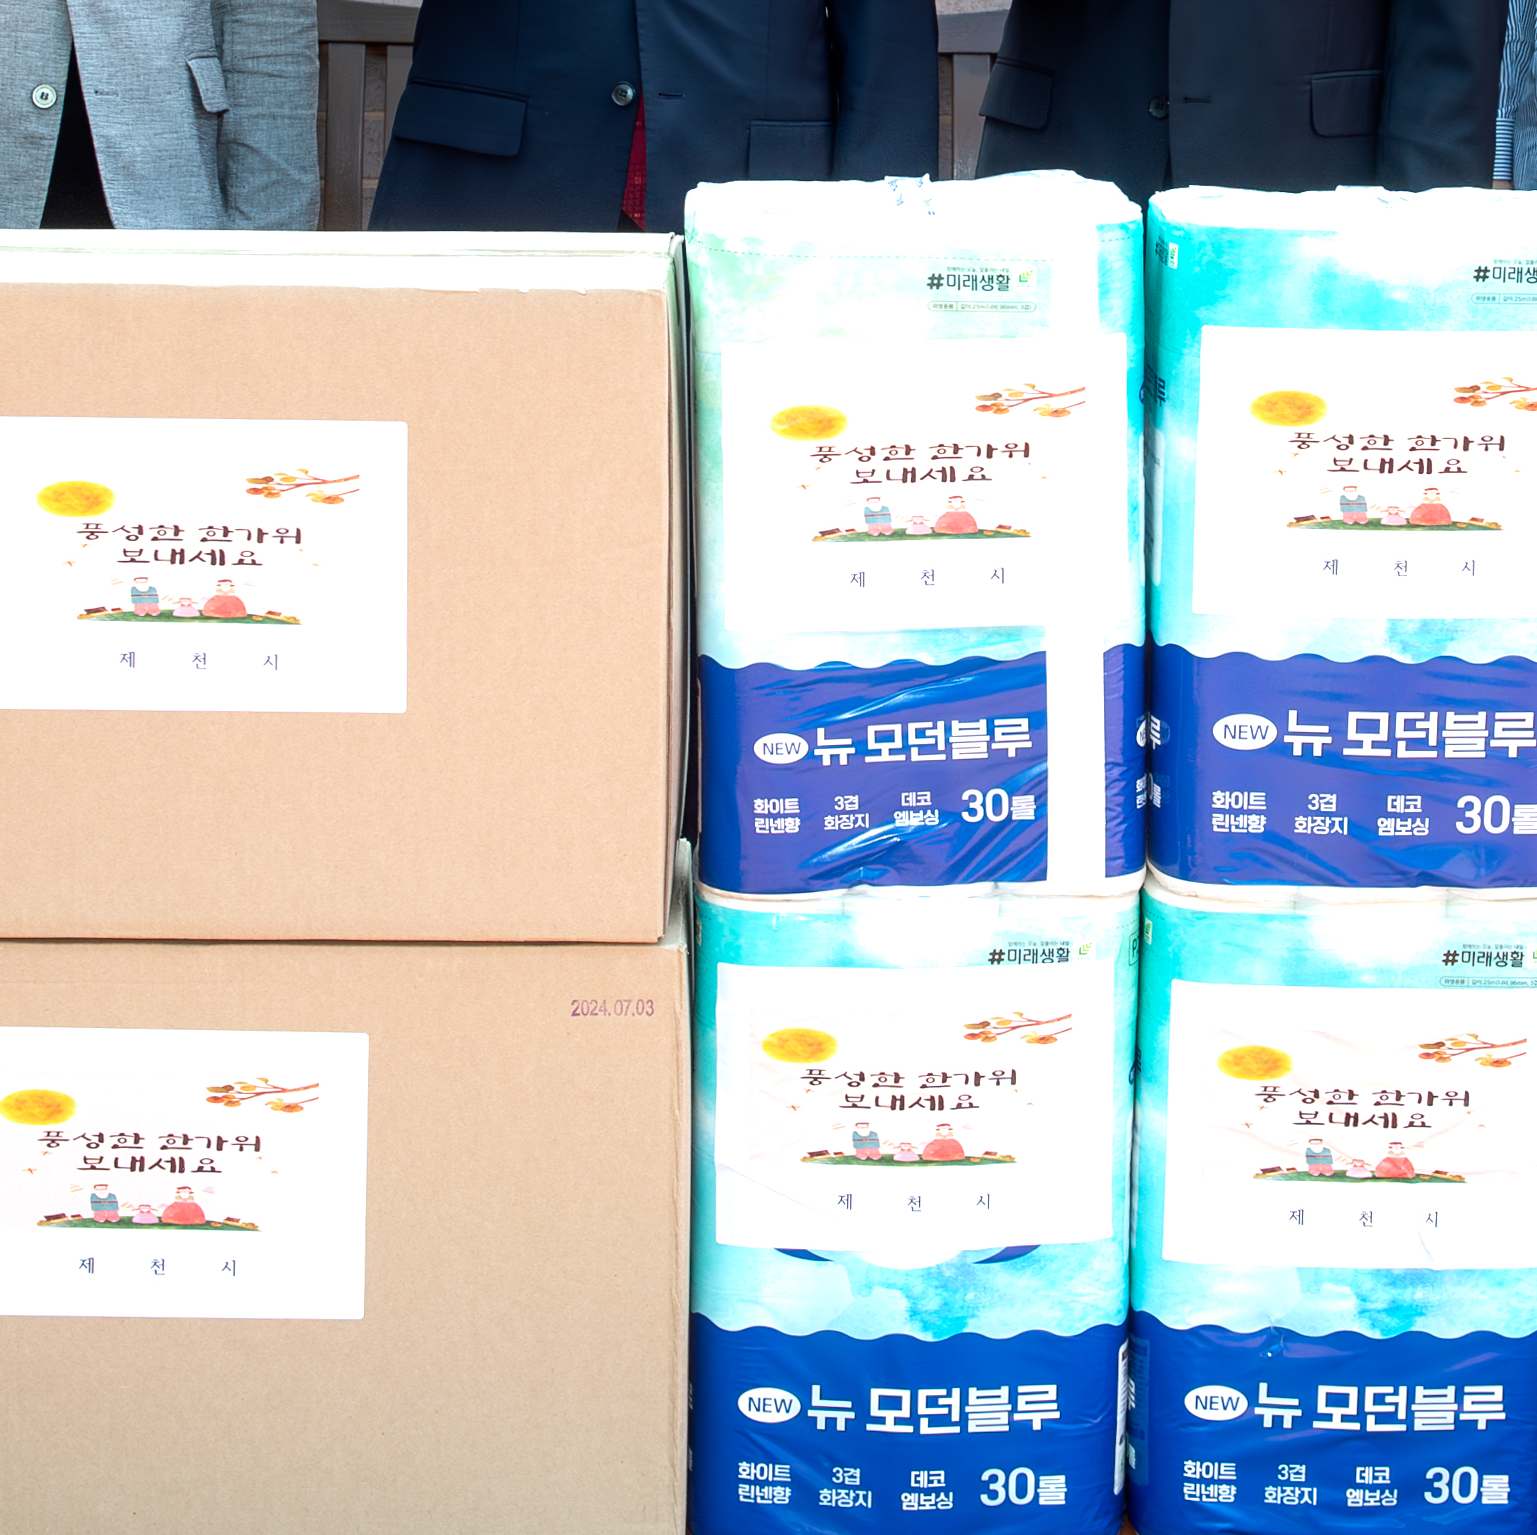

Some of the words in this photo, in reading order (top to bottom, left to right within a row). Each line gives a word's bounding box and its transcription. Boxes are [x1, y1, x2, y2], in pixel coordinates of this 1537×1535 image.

[810, 444, 916, 464] 풍성한
[929, 441, 1030, 461] 한가위
[1288, 432, 1395, 451] 풍성한
[1408, 434, 1505, 452] 한가위
[850, 465, 993, 485] 보내세요
[1327, 457, 1468, 475] 보내세요
[77, 523, 185, 542] 풍성한
[198, 525, 302, 545] 한가위
[117, 548, 263, 567] 보내세요
[762, 742, 801, 756] NEW
[813, 727, 855, 766] 뉴
[864, 718, 1032, 763] 모던블루
[1223, 724, 1269, 740] NEW
[1283, 710, 1332, 757] 뉴
[1342, 711, 1537, 758] 모던블루
[753, 798, 800, 814] 화이트
[834, 795, 859, 811] 3겹
[901, 792, 932, 807] 데코
[961, 788, 1036, 823] 30롤
[1211, 790, 1266, 811] 화이트
[1308, 794, 1337, 811] 3겹
[1387, 795, 1422, 813] 데코
[754, 817, 800, 834] 린넨향
[824, 814, 869, 830] 화장지
[894, 809, 939, 826] 엠보싱
[1211, 814, 1266, 833] 린넨향
[1293, 816, 1348, 835] 화장지
[1377, 817, 1429, 836] 엠보싱
[571, 998, 655, 1019] 2024.07.03
[800, 1068, 905, 1089] 풍성한
[919, 1068, 1017, 1089] 한가위
[839, 1093, 980, 1112] 보내세요
[1255, 1085, 1359, 1106] 풍성한
[1373, 1089, 1470, 1108] 한가위
[1293, 1110, 1432, 1129] 보내세요
[38, 1130, 145, 1150] 풍성한
[158, 1133, 261, 1153] 한가위
[77, 1155, 223, 1174] 보내세요
[747, 1396, 793, 1414] NEW
[807, 1384, 855, 1431] 뉴
[866, 1384, 1060, 1435] 모던블루
[1194, 1394, 1240, 1411] NEW
[1254, 1382, 1302, 1429] 뉴
[1312, 1384, 1506, 1432] 모던블루
[738, 1462, 791, 1482] 화이트
[832, 1467, 860, 1485] 3겹
[911, 1470, 945, 1488] 데코
[979, 1467, 1068, 1506] 30롤
[1183, 1460, 1237, 1480] 화이트
[1277, 1464, 1306, 1482] 3겹
[1355, 1466, 1390, 1484] 데코
[1424, 1466, 1510, 1504] 30롤
[738, 1485, 791, 1504] 린넨향
[818, 1488, 872, 1508] 화장지
[901, 1491, 953, 1510] 엠보싱
[1183, 1483, 1236, 1502] 린넨향
[1264, 1486, 1318, 1505] 화장지
[1346, 1488, 1397, 1507] 엠보싱
